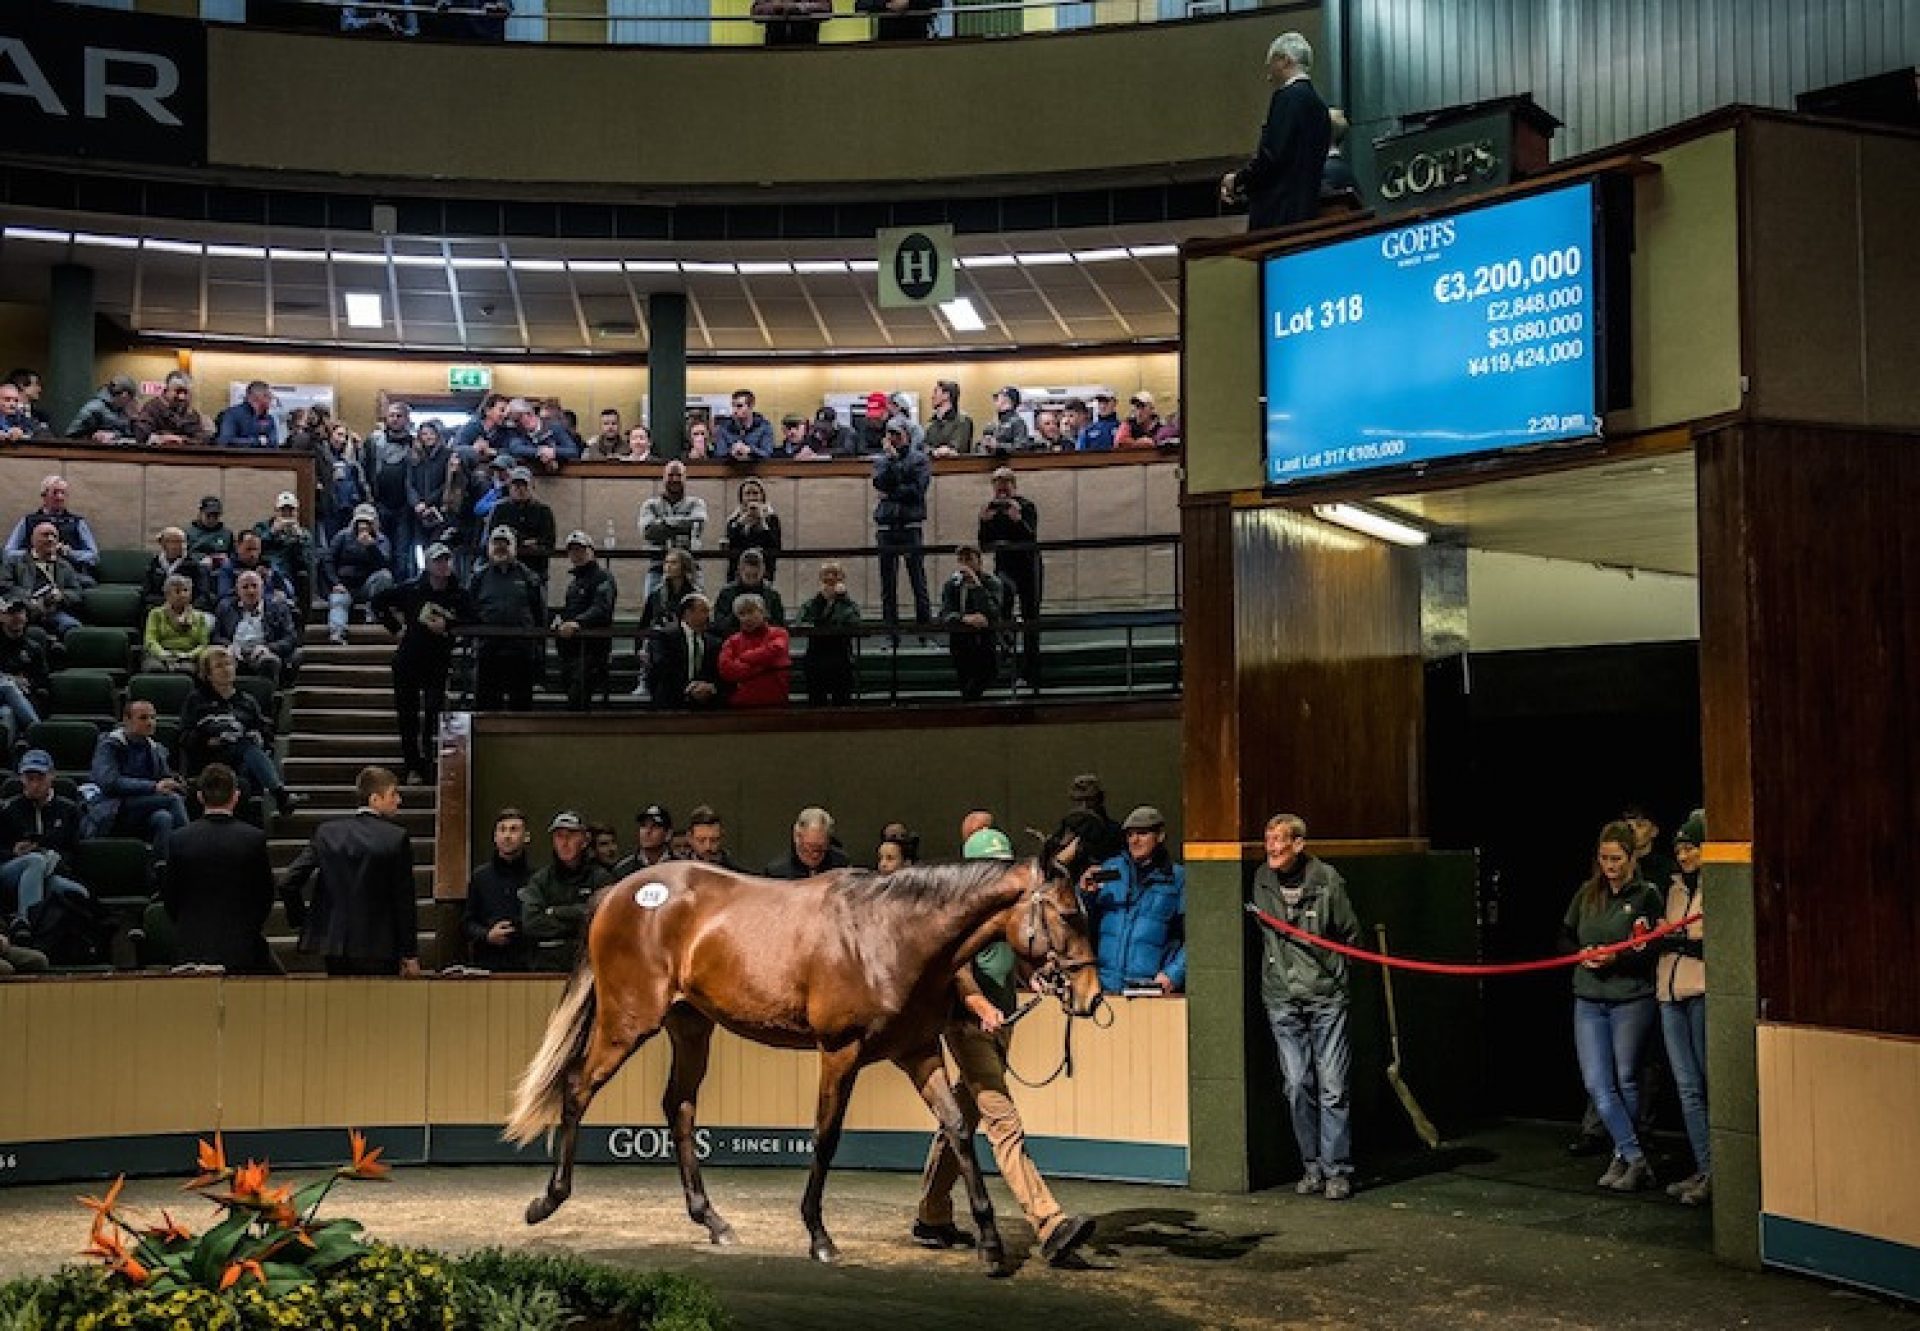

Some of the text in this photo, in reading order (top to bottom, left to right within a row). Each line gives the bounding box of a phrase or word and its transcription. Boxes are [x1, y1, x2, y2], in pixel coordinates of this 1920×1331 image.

[1382, 219, 1456, 259] GOFFS
[900, 250, 932, 285] H
[1434, 246, 1581, 303] €3,200,000
[1274, 294, 1363, 338] Lot 318
[1488, 312, 1583, 349] $3,680,000
[608, 1127, 713, 1159] GOFS
[731, 1137, 780, 1154] SINCE
